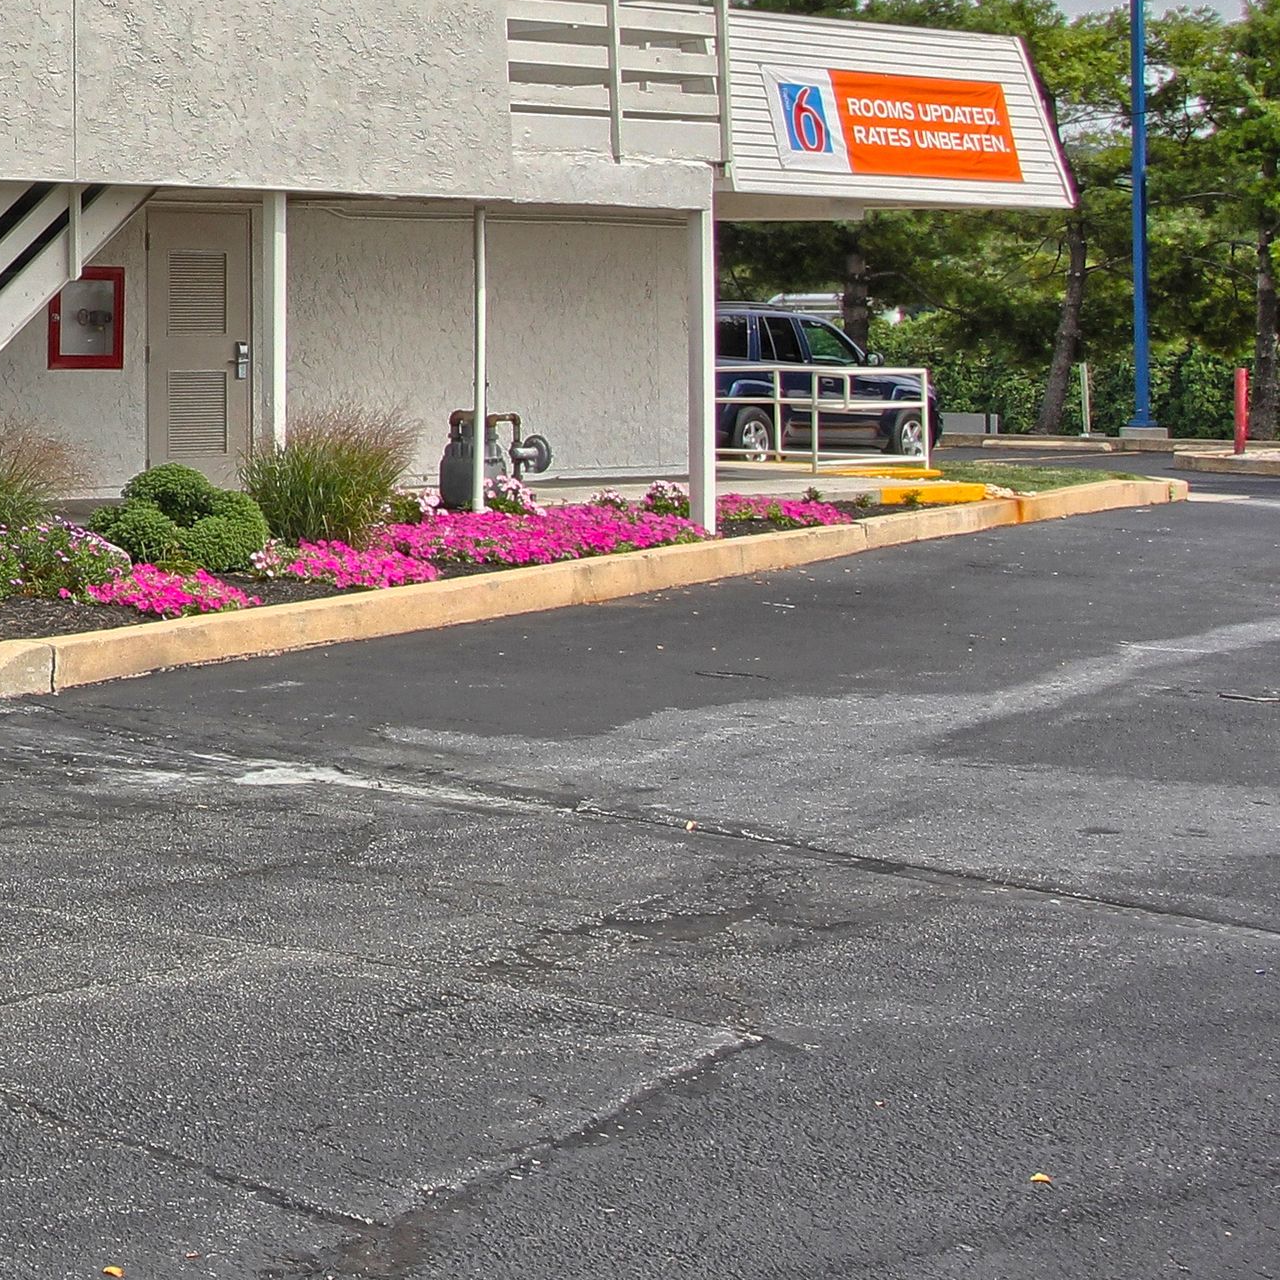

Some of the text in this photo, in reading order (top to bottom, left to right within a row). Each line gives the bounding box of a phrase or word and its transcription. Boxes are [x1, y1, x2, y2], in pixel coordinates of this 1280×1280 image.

[792, 86, 825, 154] 6
[846, 97, 1001, 126] ROOMS UPDATED.
[853, 125, 1011, 153] RATES UNBEATEN.
